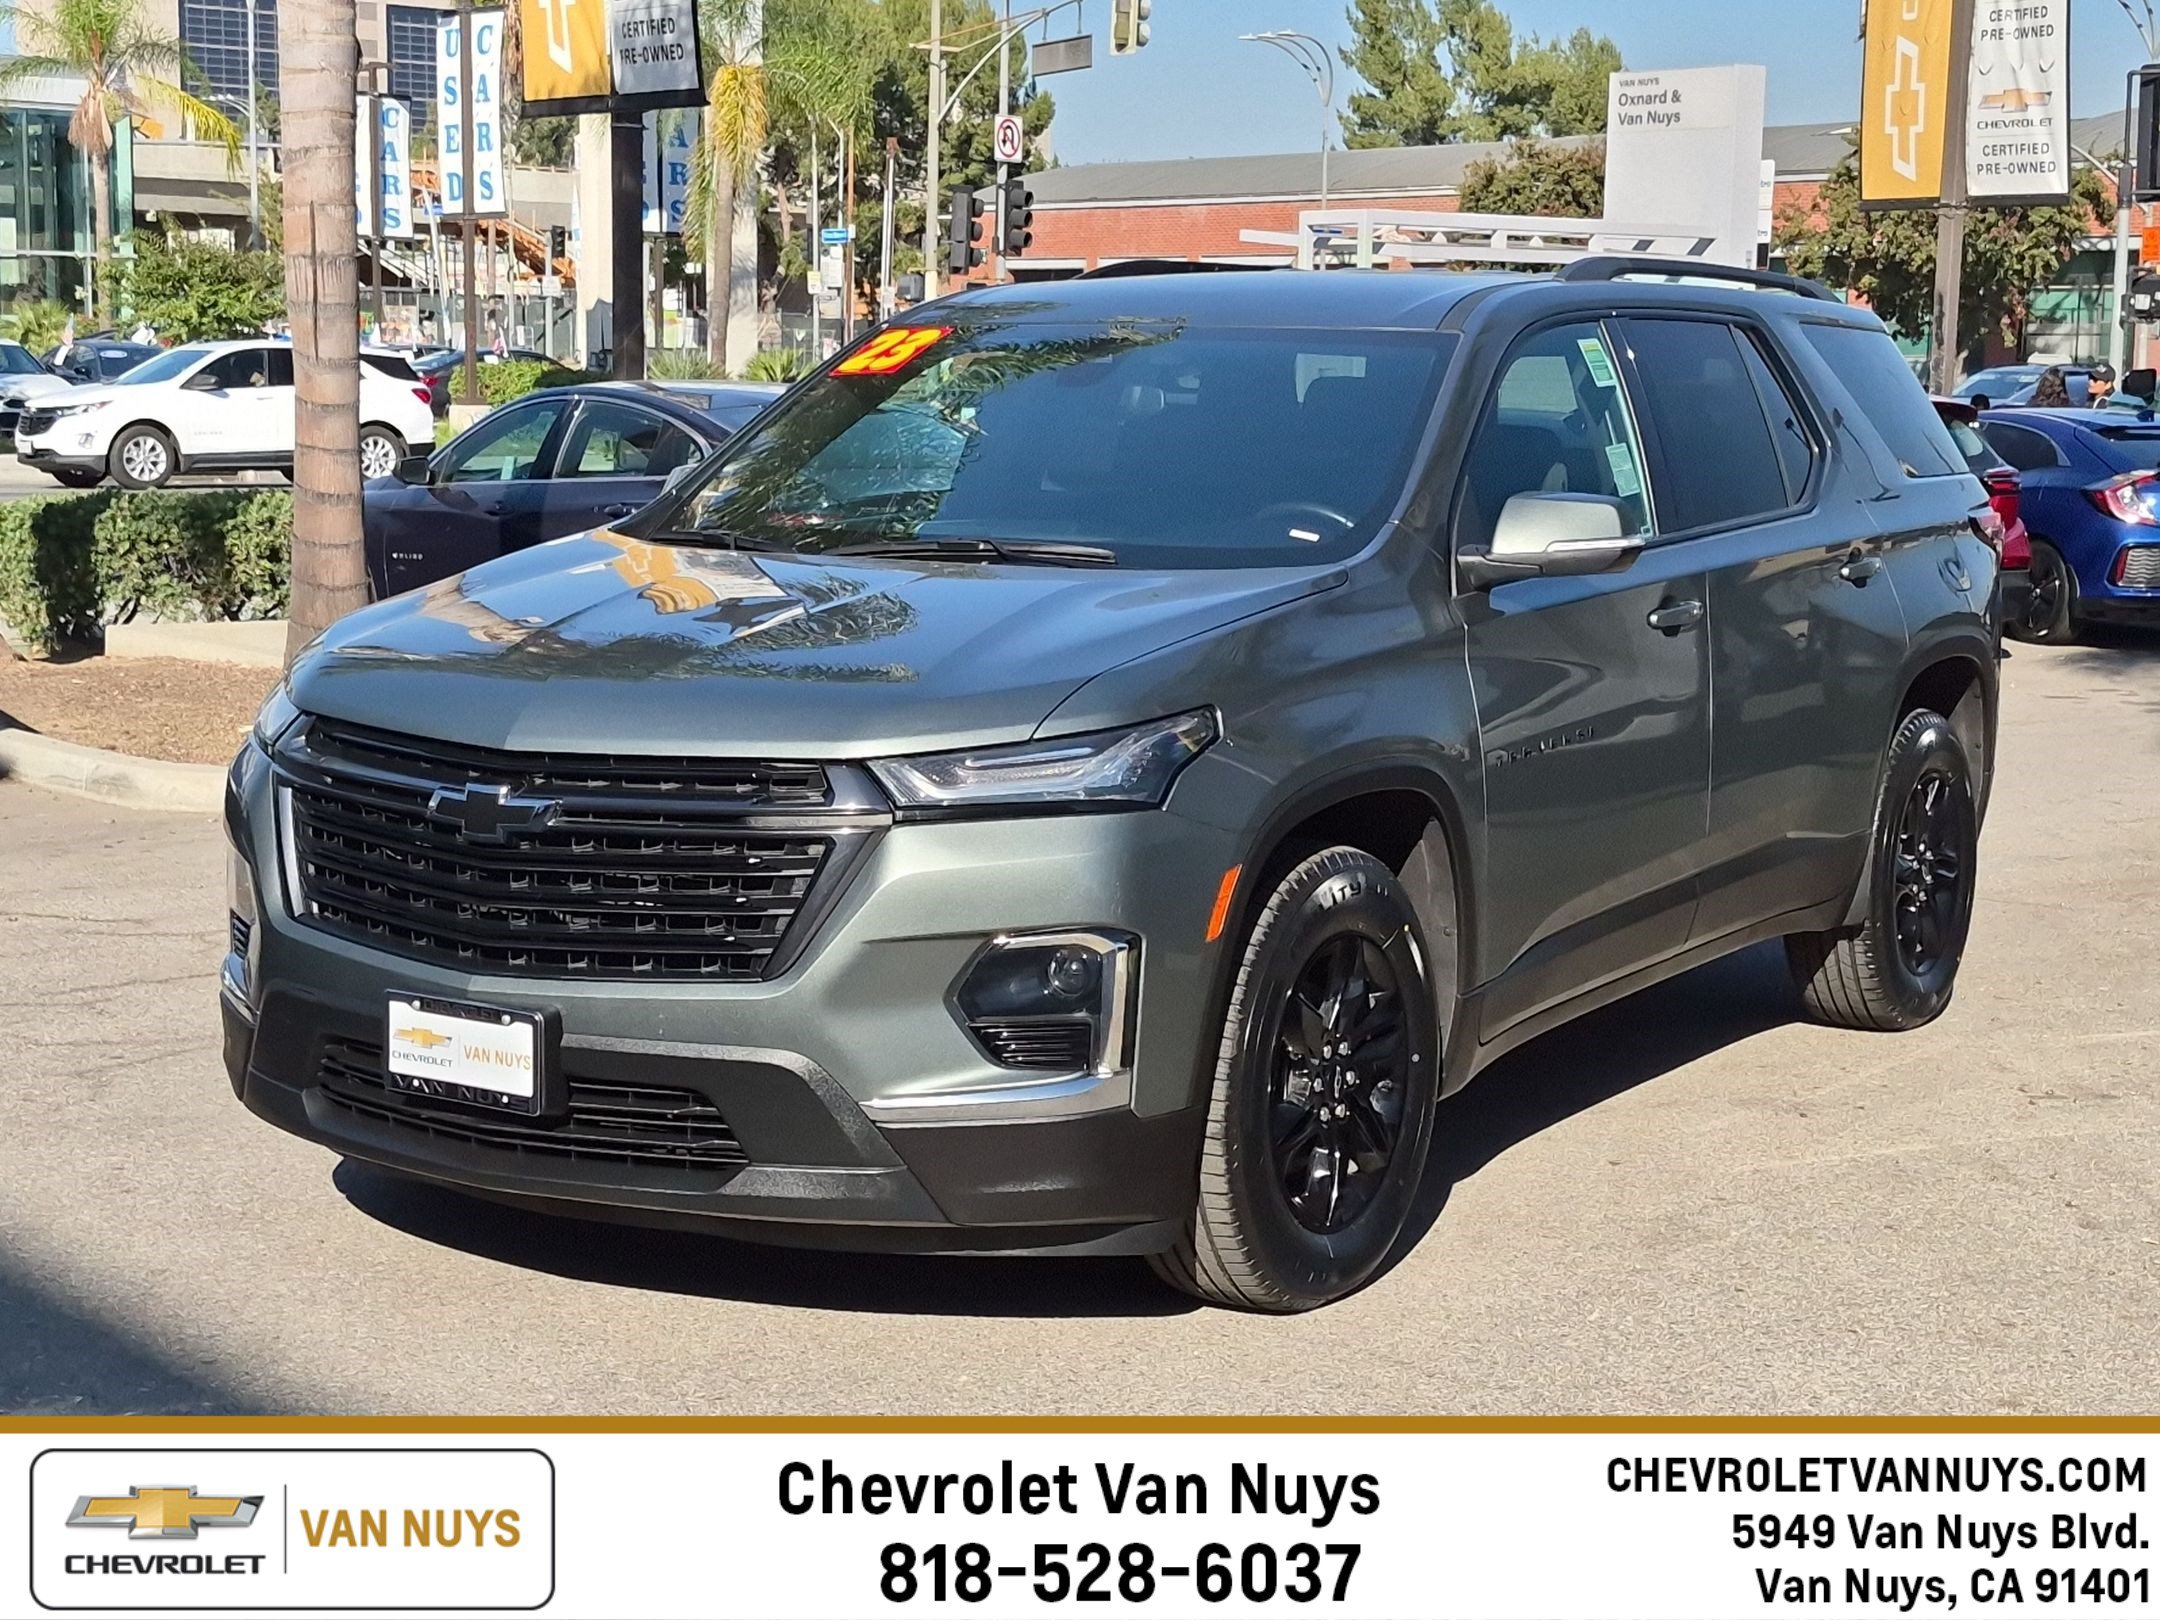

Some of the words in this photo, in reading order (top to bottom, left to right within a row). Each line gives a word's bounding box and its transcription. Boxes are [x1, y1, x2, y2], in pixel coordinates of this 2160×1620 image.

[1989, 5, 2048, 22] CERTIFIED
[621, 17, 676, 39] CERTIFIED
[1980, 24, 2054, 41] PRE-OWNED
[1619, 79, 1635, 87] VAN
[1637, 77, 1659, 87] NUYS
[1618, 89, 1667, 107] Oxnard
[1671, 89, 1682, 103] &
[444, 28, 463, 201] USED
[476, 24, 494, 201] CARS
[1618, 112, 1643, 126] Van
[1646, 110, 1681, 127] Nuys
[1977, 117, 2053, 130] CHEVROLET
[1982, 143, 2050, 157] CERTIFIED
[380, 107, 402, 228] CARS
[1977, 161, 2056, 175] PRE-OWNED
[837, 328, 942, 373] 23
[392, 1050, 453, 1068] CHEVROLET
[464, 1045, 490, 1064] VAN
[495, 1049, 531, 1070] NUYS
